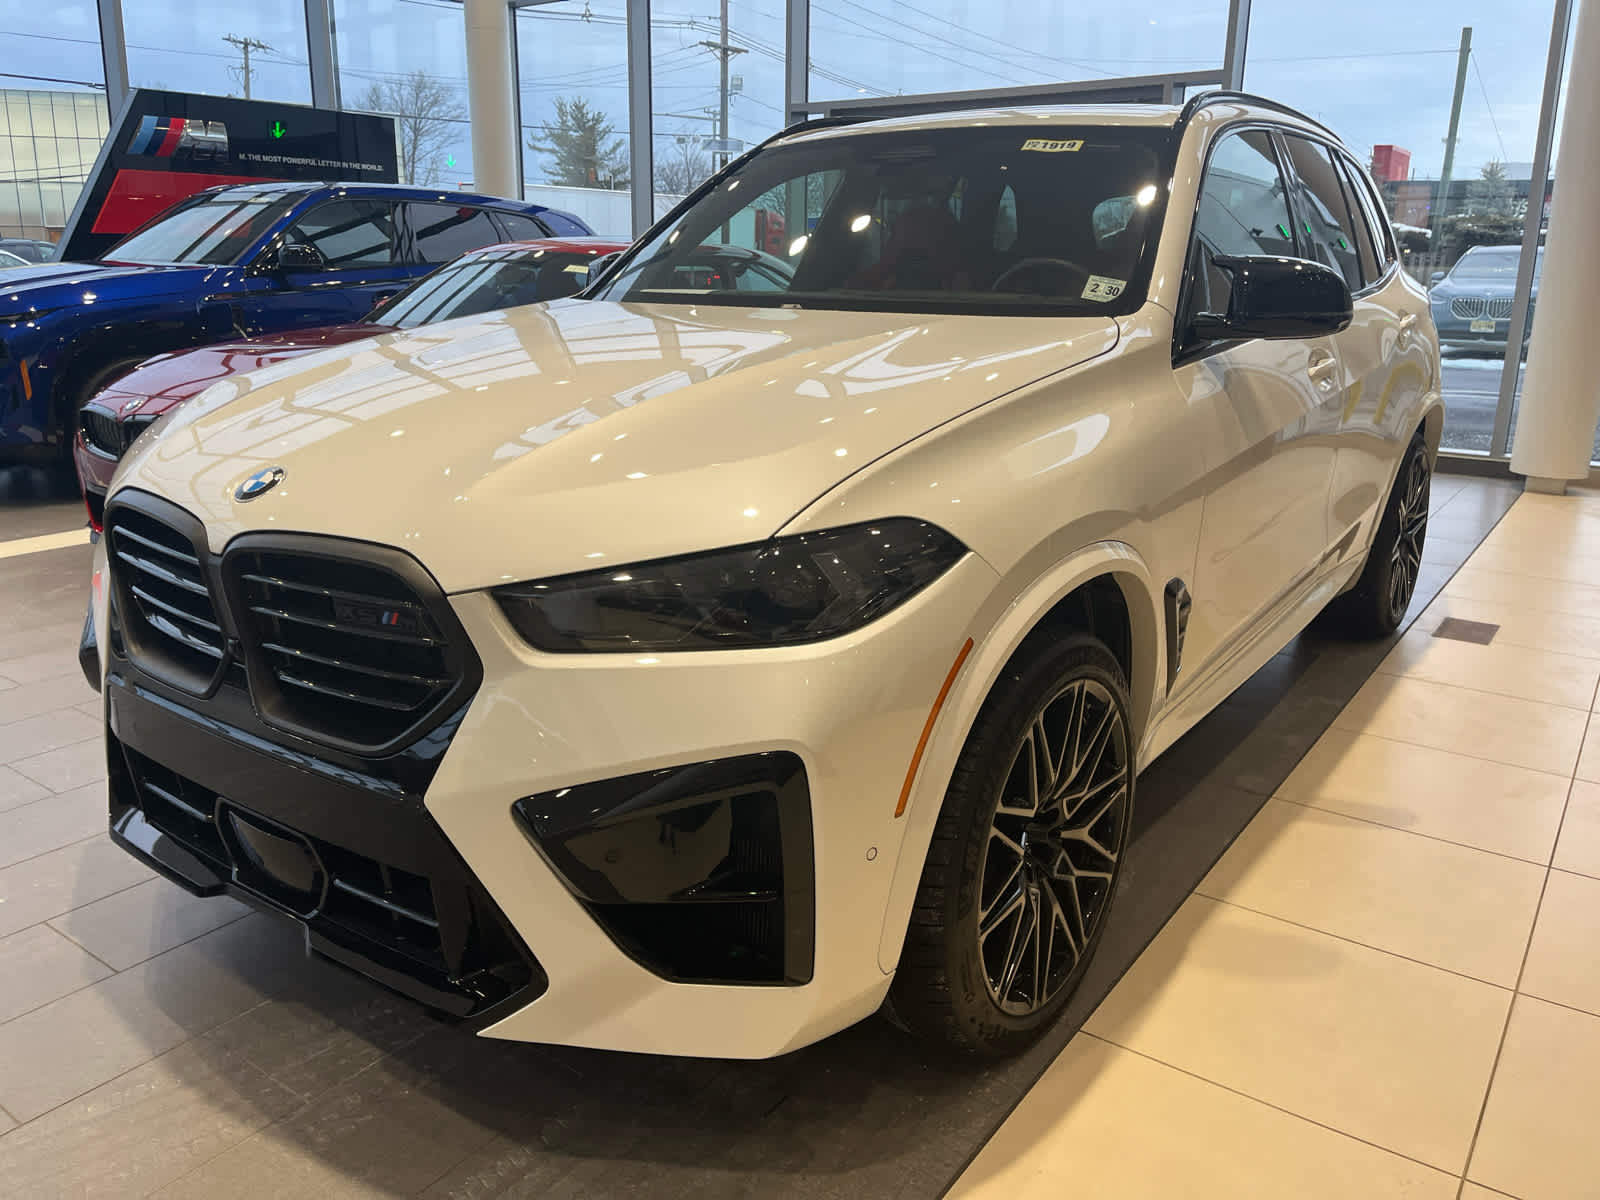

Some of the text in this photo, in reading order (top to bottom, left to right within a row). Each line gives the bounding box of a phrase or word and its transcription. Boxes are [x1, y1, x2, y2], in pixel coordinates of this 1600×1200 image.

[248, 154, 261, 162] THE
[262, 155, 281, 163] MOST
[283, 157, 317, 166] POWERFUL
[318, 160, 341, 168] LETTER
[1090, 283, 1120, 297] 2 30
